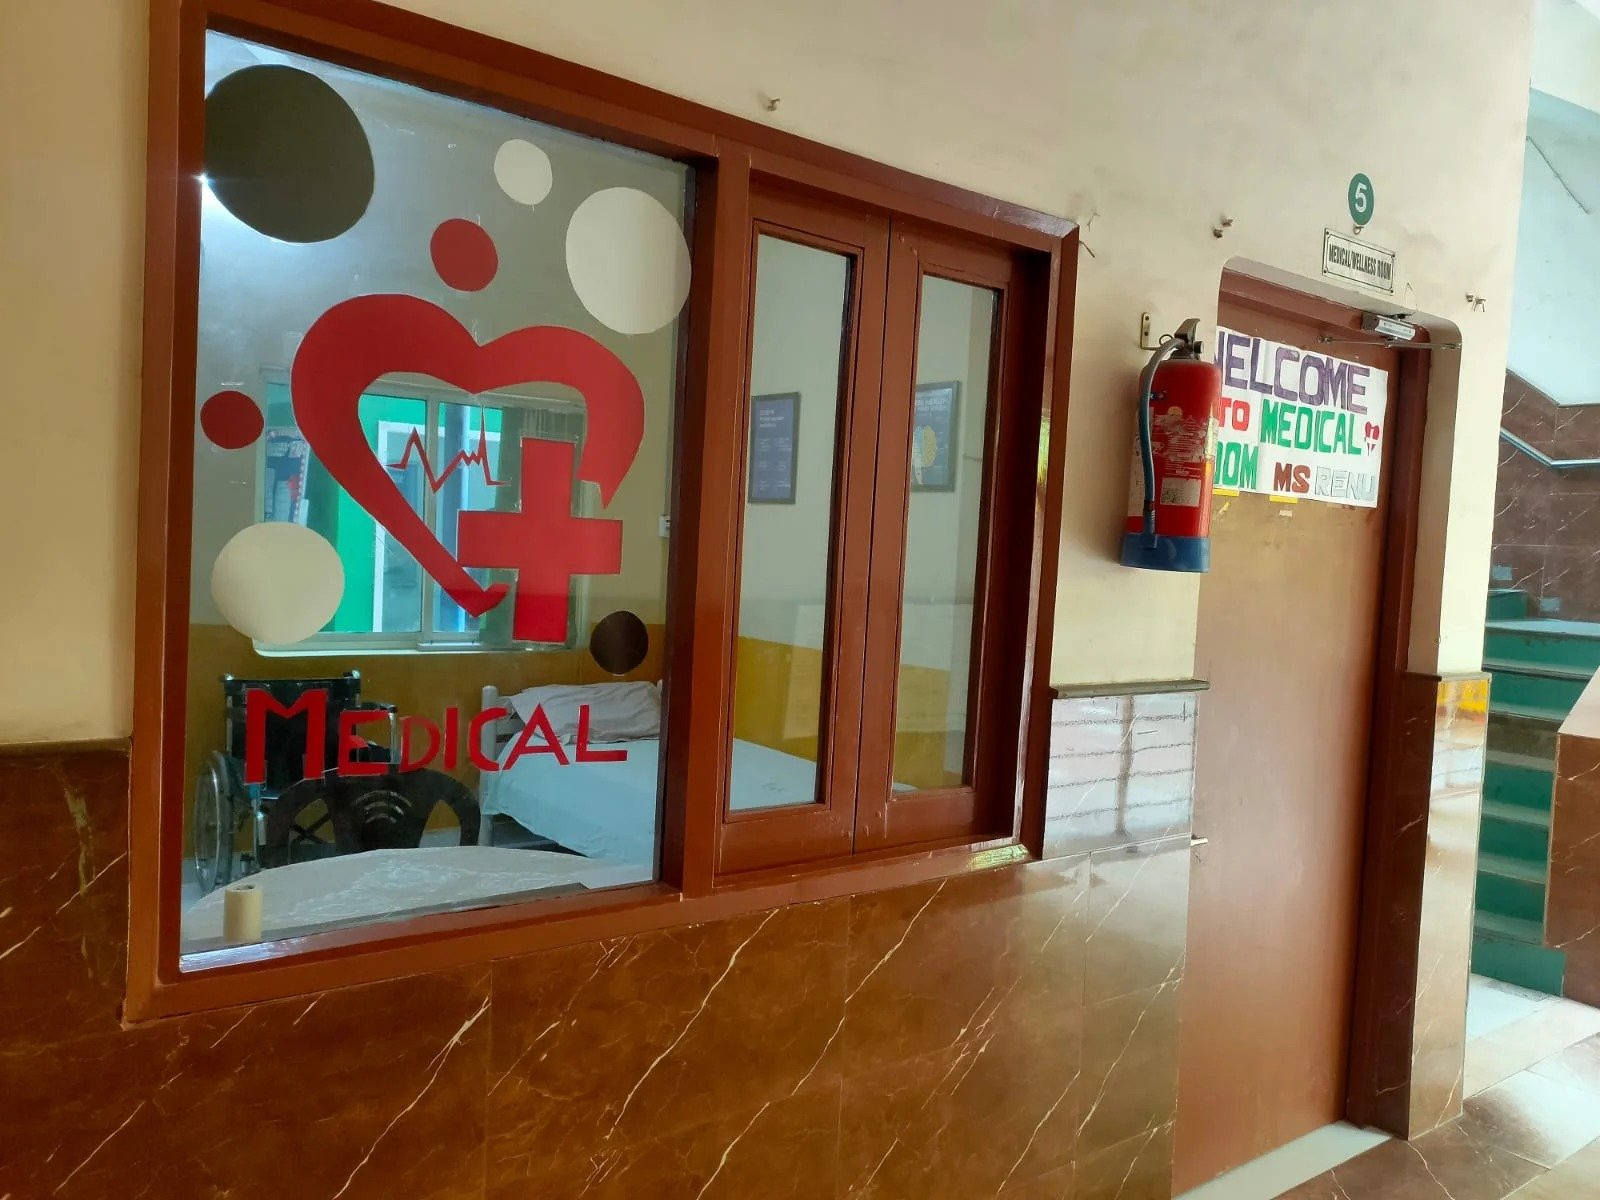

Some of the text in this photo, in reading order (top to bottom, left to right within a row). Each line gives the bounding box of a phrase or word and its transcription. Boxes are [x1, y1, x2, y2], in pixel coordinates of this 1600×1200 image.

[1355, 182, 1367, 212] 5
[1377, 259, 1392, 280] ROOM
[1218, 397, 1362, 455] TO MEDICAL
[1273, 462, 1311, 494] MS
[1315, 466, 1376, 500] RENU
[245, 688, 628, 785] MEDICAL
